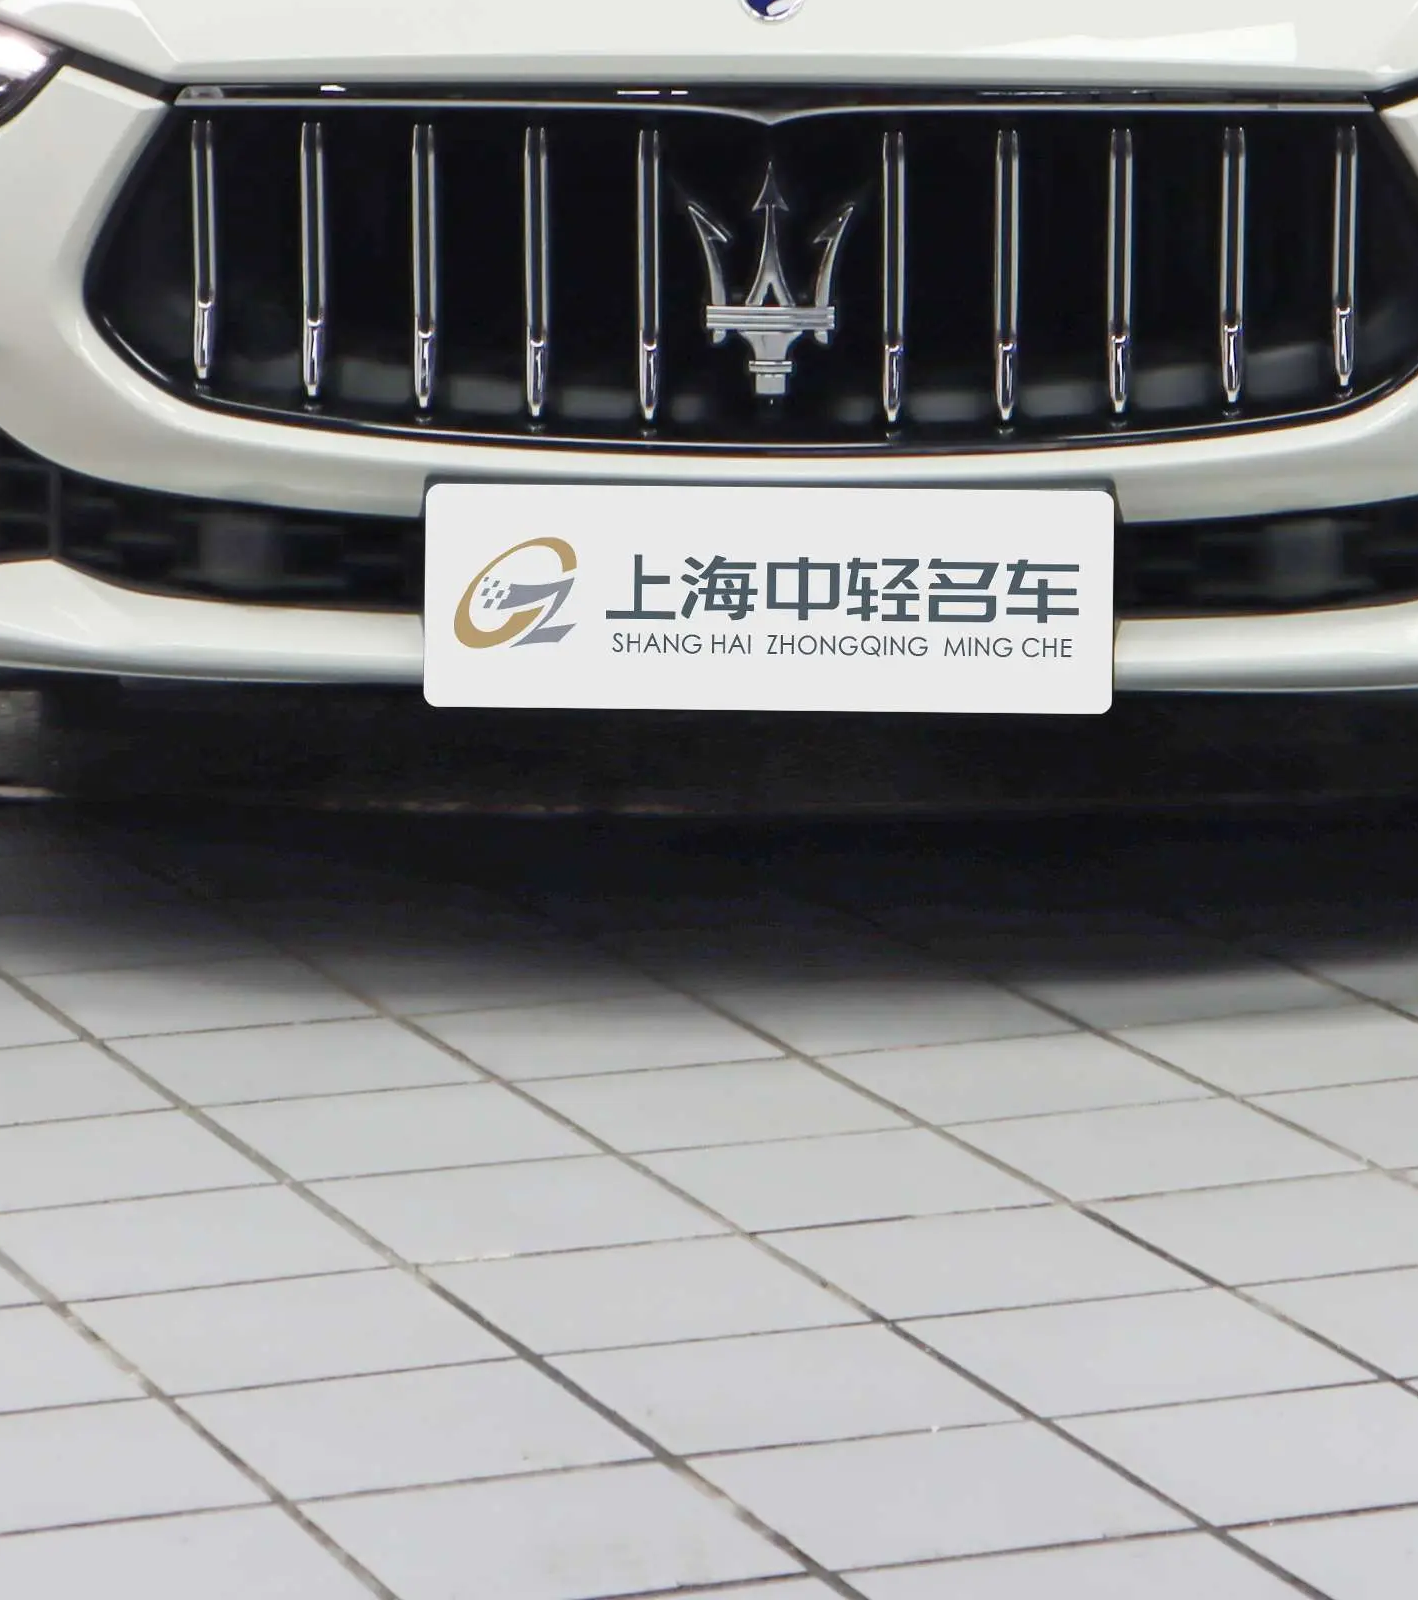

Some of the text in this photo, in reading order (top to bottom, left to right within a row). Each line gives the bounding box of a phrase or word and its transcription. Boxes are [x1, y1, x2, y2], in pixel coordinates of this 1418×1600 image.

[605, 554, 1080, 624] 上海中轻名车
[612, 632, 1073, 658] SHANG HAI ZHONGQING MING CHE
